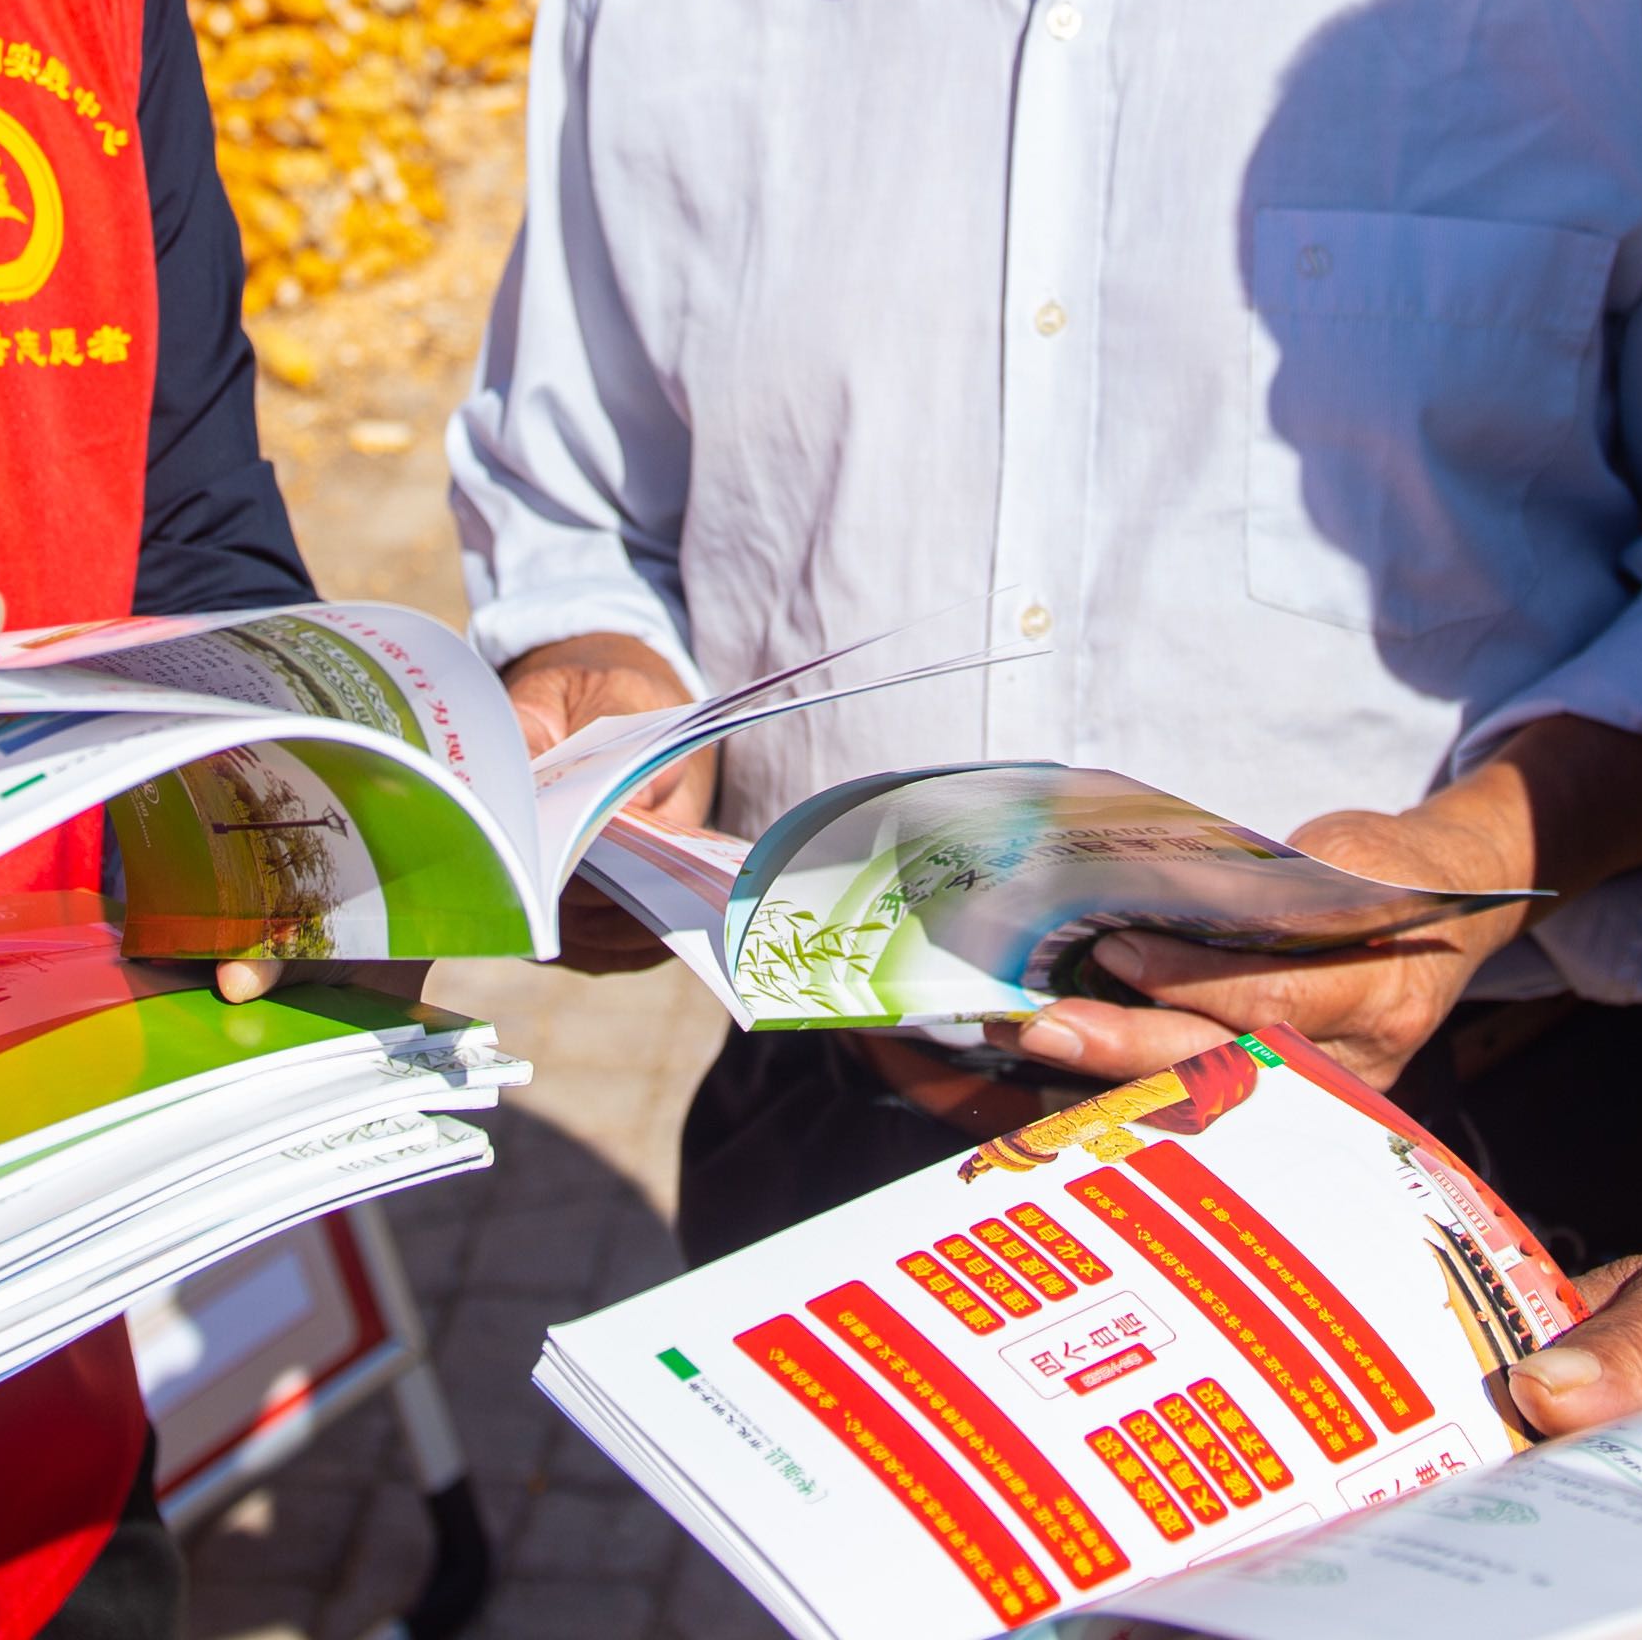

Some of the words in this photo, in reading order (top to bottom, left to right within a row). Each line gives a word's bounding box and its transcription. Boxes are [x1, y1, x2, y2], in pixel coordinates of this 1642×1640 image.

[945, 1241, 1031, 1312] 理论自信
[981, 1224, 1066, 1294] 制度自信
[1017, 1208, 1103, 1277] 文化自信
[908, 1258, 995, 1329] 道路自信
[1201, 1198, 1409, 1416] 坚决维护党中央权威和集中统一领导
[1031, 1313, 1145, 1376] 四个自信
[839, 1313, 1092, 1575] 确立习近平新时代中国特色社会主义思想的
[1197, 1383, 1282, 1483] 看齐意识
[1310, 1377, 1364, 1442] 核心地位
[1095, 1432, 1184, 1533] 政治意识
[1130, 1415, 1219, 1515] 大局意识
[1164, 1399, 1251, 1498] 核心意识
[1056, 1498, 1114, 1565] 指导地位
[1013, 1567, 1045, 1603] 地位
